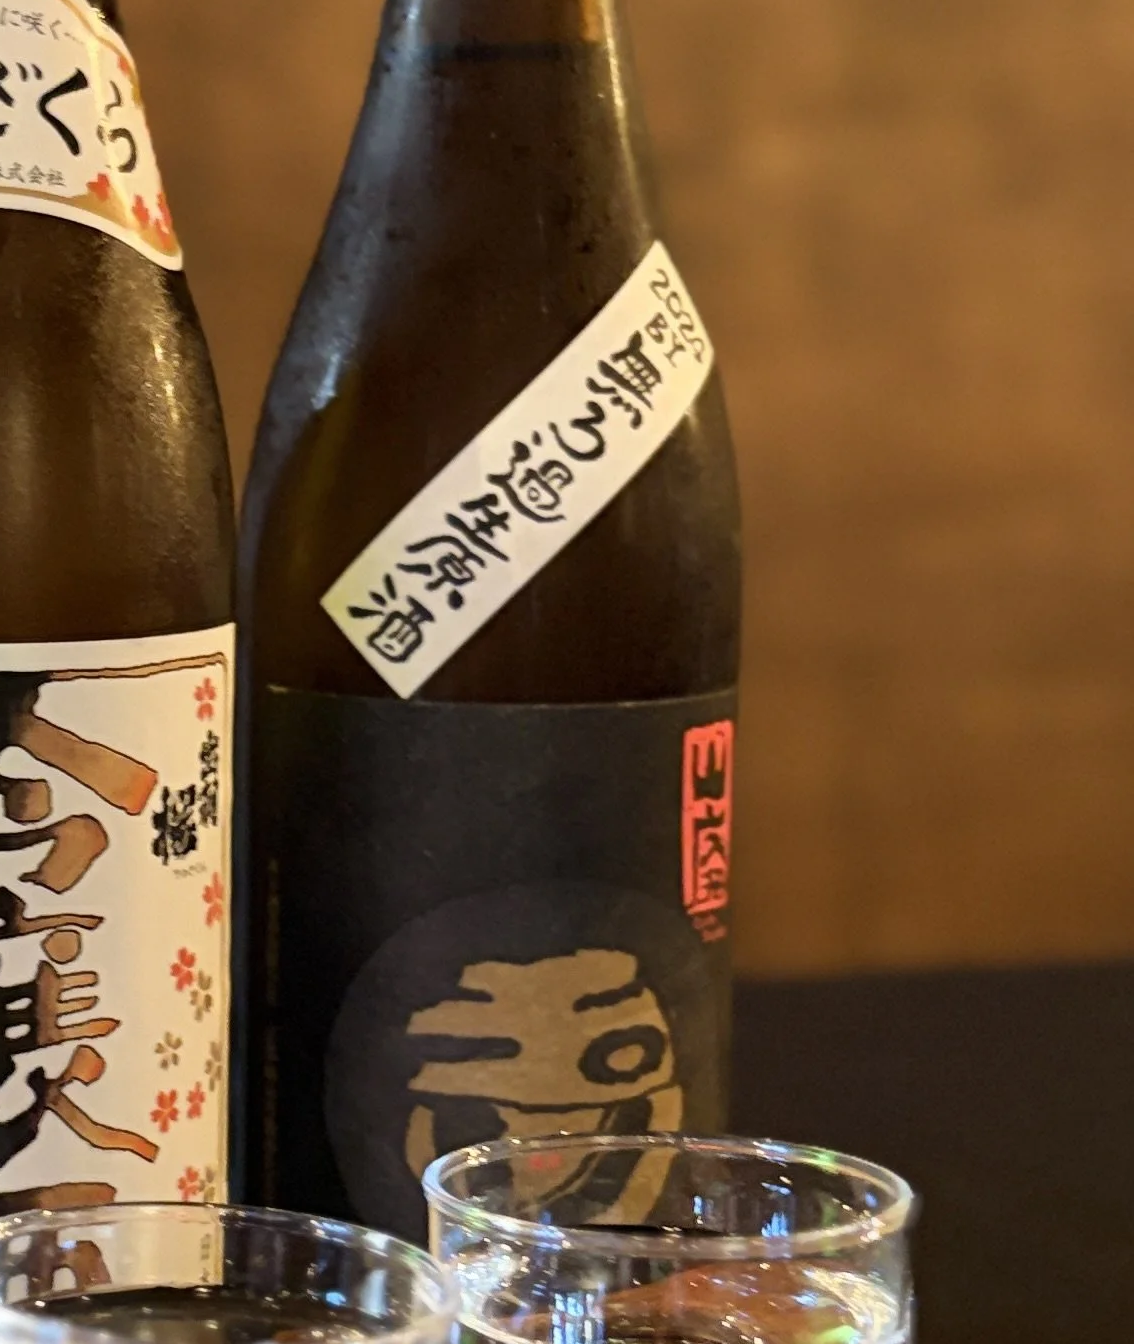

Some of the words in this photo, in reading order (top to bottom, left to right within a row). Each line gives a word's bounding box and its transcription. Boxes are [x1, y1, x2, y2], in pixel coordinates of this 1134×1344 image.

[644, 311, 686, 368] BY
[347, 330, 663, 663] 無ろ過生原酒
